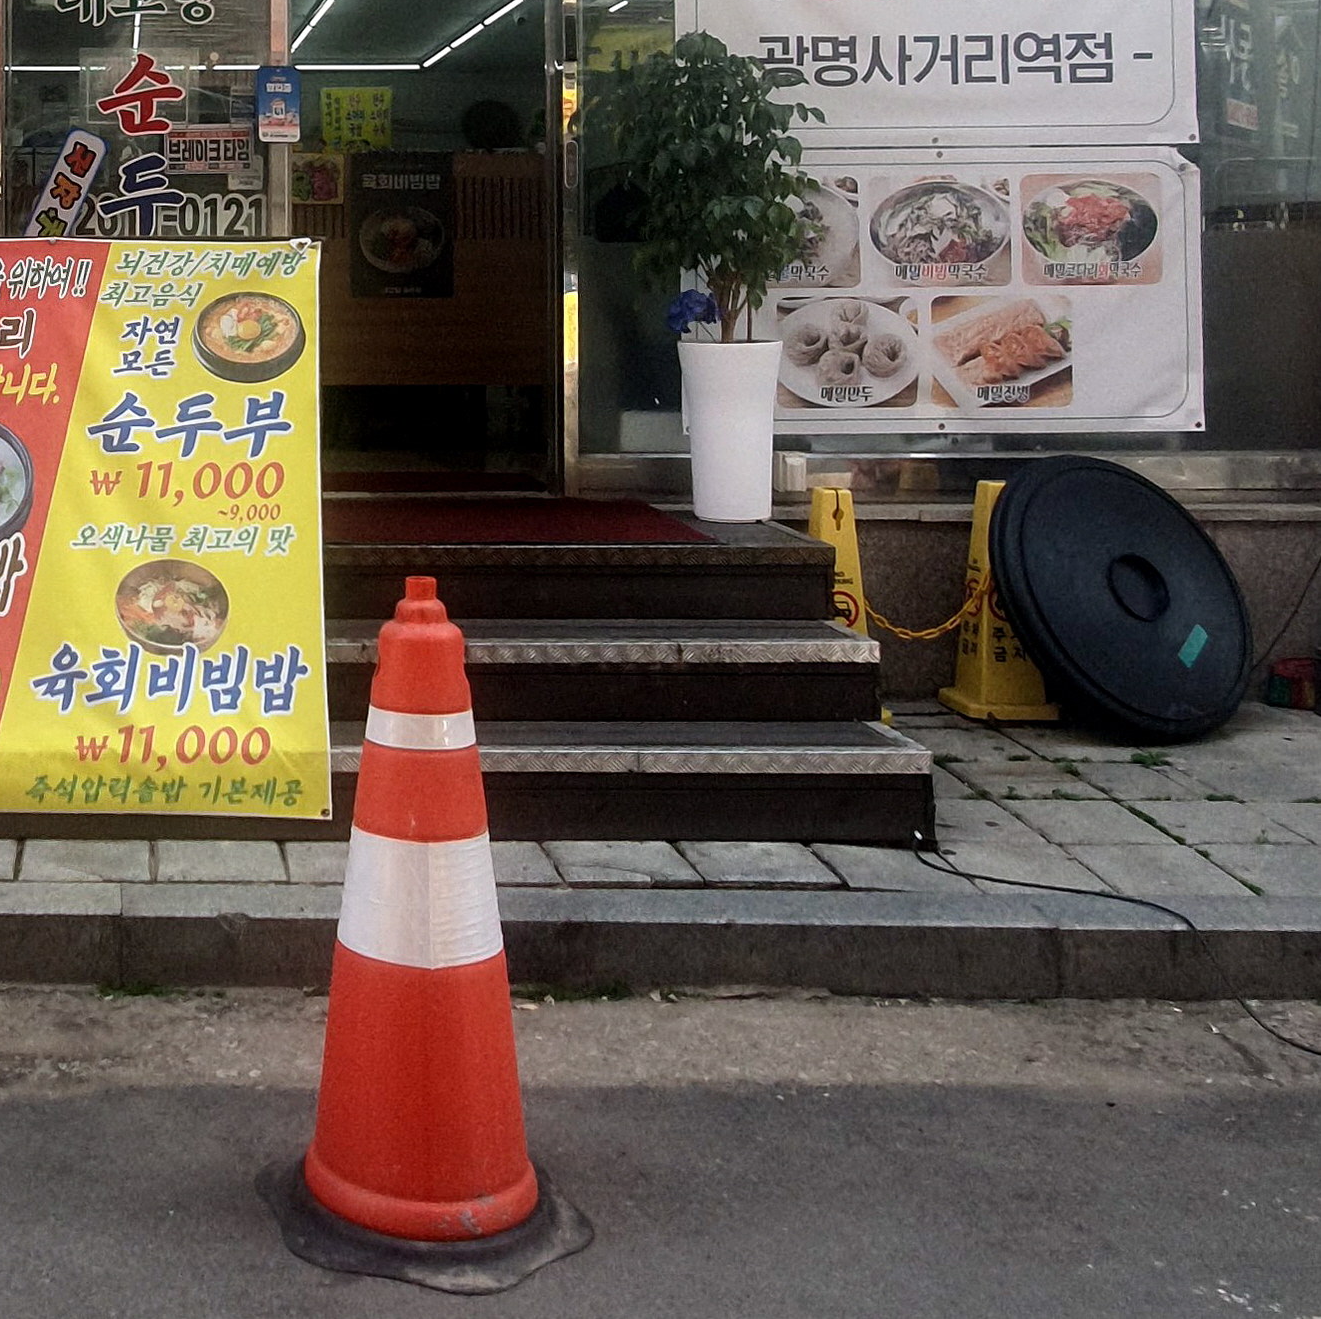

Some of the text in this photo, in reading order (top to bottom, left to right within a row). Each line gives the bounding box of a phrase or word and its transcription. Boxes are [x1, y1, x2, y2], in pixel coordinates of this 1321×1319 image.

[757, 31, 1114, 86] 광명사거리역점
[96, 51, 186, 236] 순두
[168, 138, 250, 162] 브레이크타임
[36, 141, 96, 236] 신장개
[115, 250, 307, 278] 뇌건강/치매예방
[894, 262, 988, 281] 메밀비빔막국수
[99, 281, 205, 309] 최고음식
[120, 315, 181, 347] 자연
[112, 348, 177, 378] 모든
[820, 385, 873, 403] 메밀만두
[85, 389, 293, 459] 순두부
[70, 523, 295, 555] 오색나물 최고의 맛
[30, 642, 311, 715] 육회비빔밥
[198, 774, 304, 807] 기본제공
